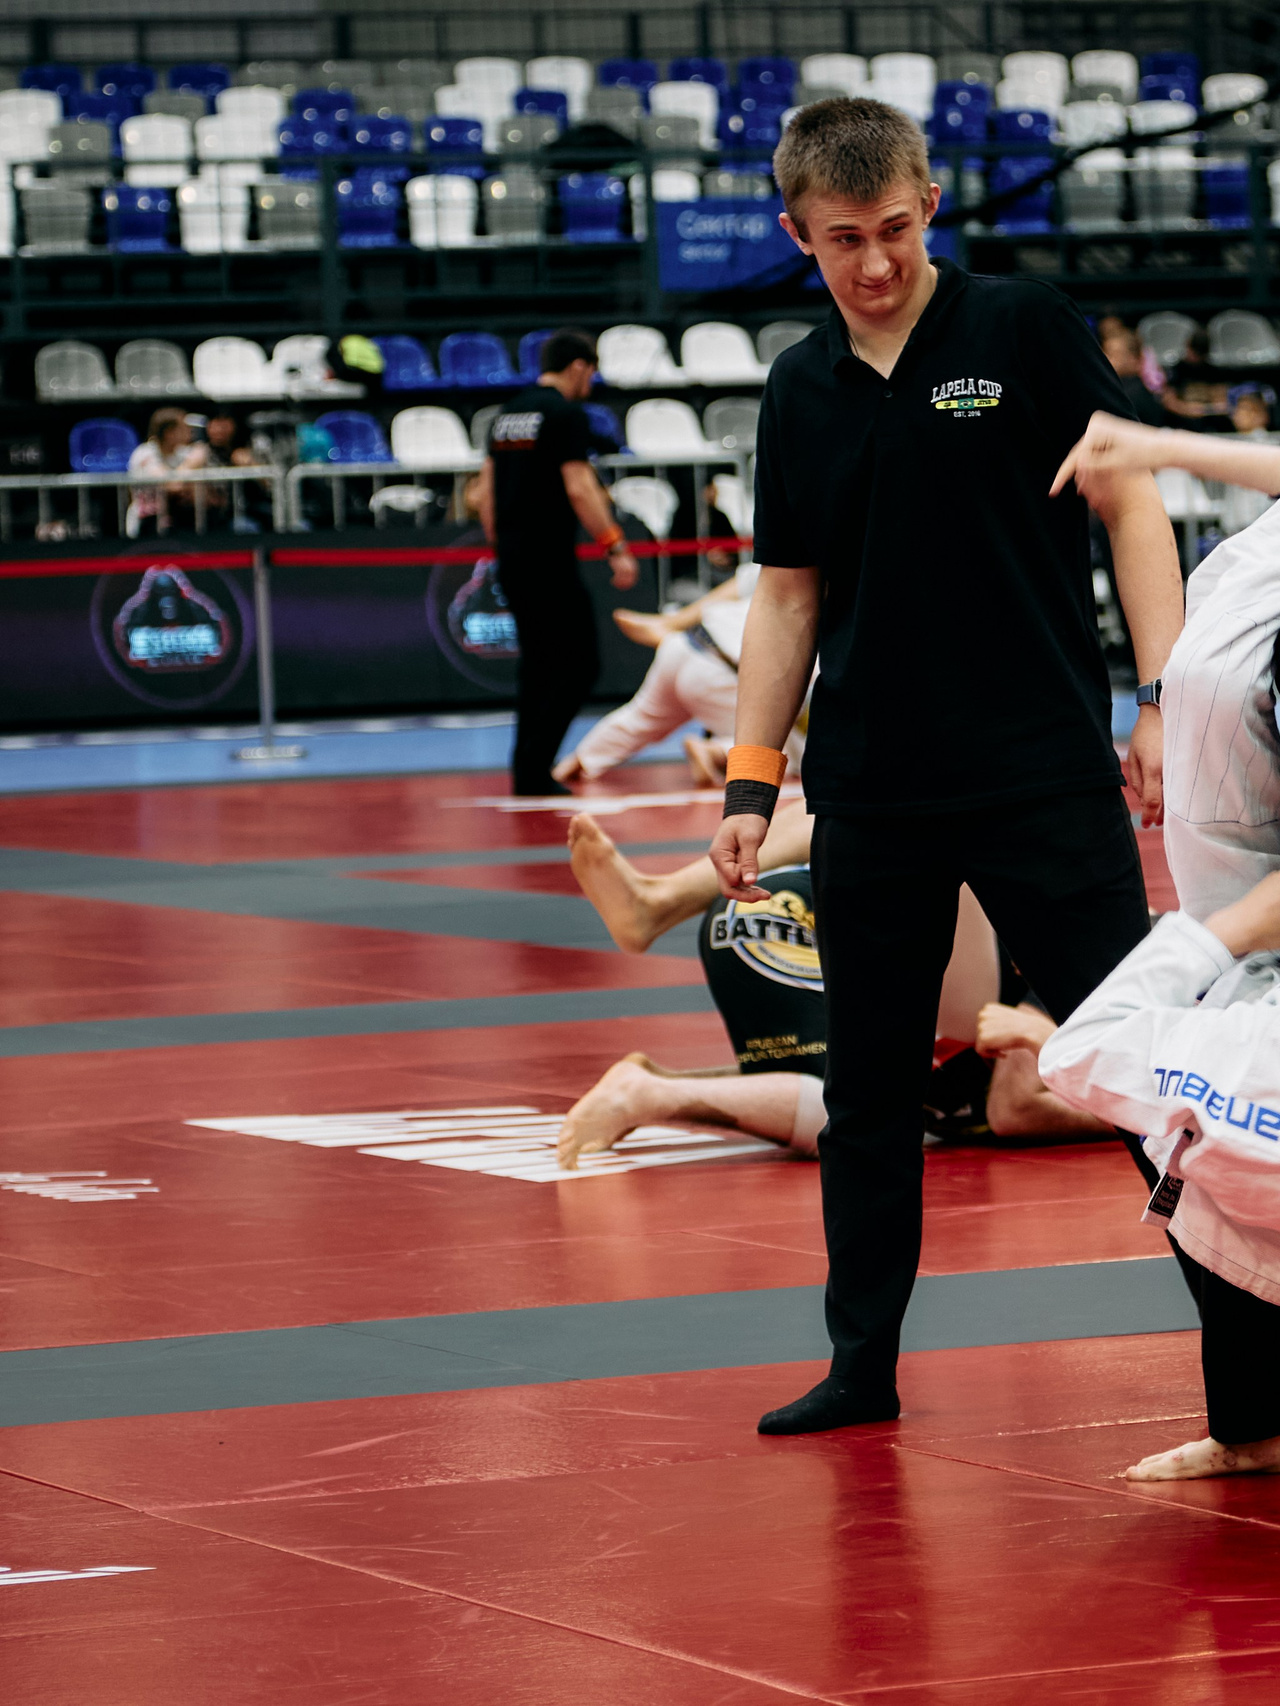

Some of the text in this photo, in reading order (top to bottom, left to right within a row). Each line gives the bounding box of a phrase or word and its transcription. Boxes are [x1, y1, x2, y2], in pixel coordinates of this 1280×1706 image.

[931, 379, 1002, 402] LAPELA CUP
[714, 916, 816, 948] BATTL
